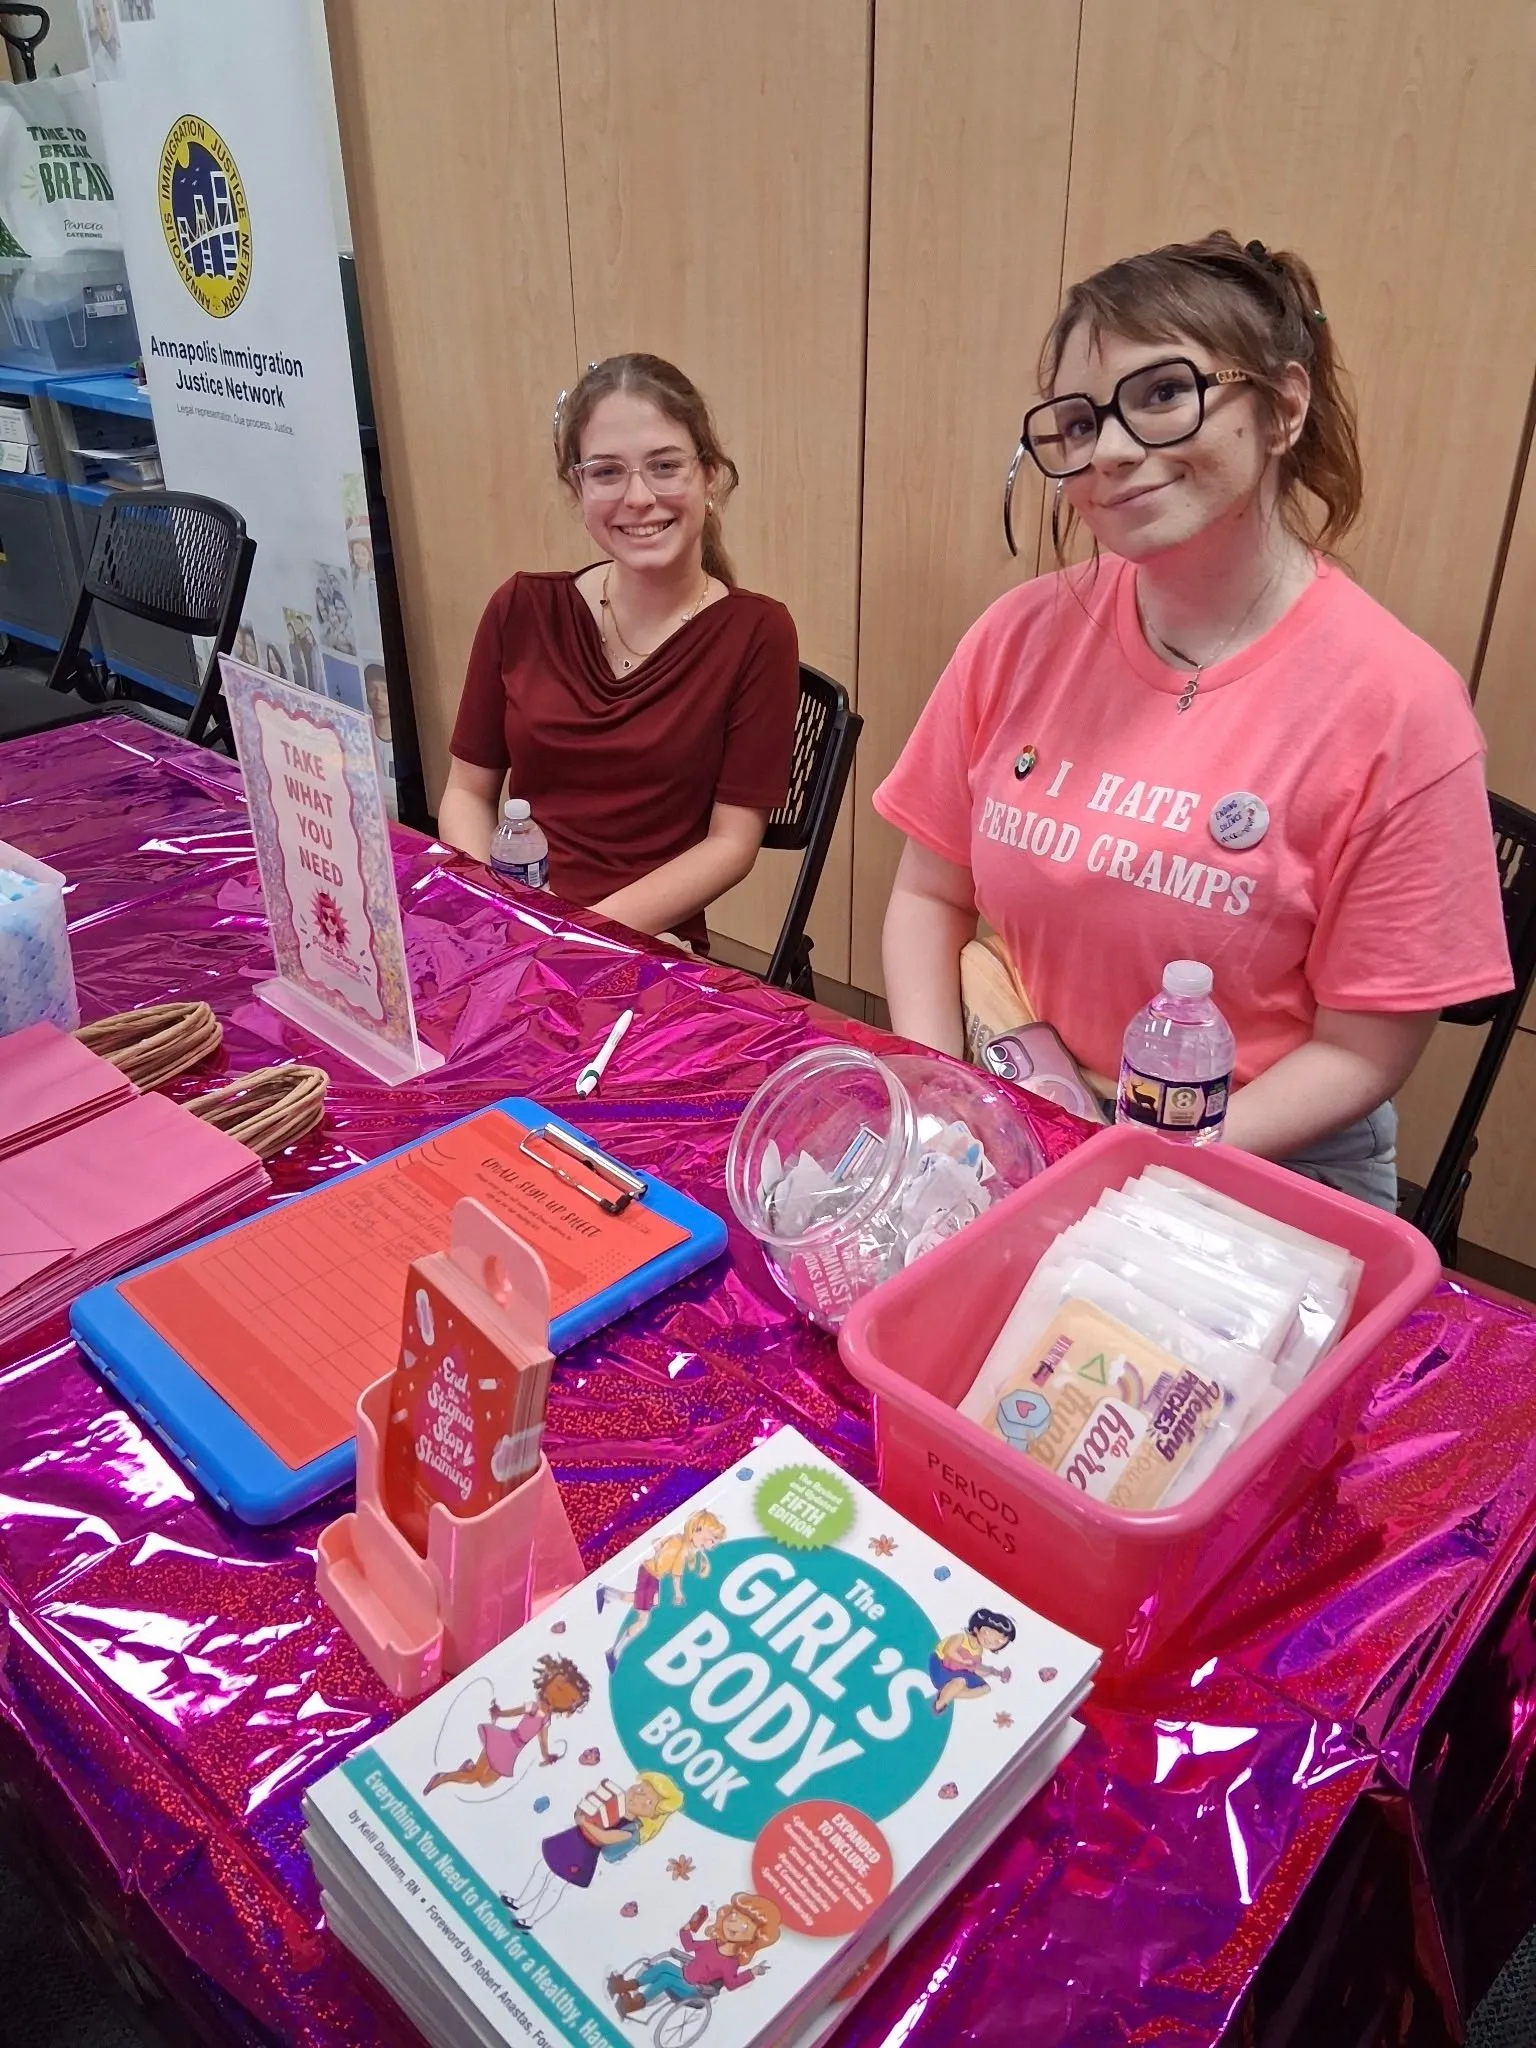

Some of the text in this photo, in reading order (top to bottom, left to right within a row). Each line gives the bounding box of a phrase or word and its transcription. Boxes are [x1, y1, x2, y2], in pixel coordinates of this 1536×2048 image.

[27, 126, 87, 142] TIME TO
[39, 144, 92, 159] BREAK
[39, 162, 114, 203] BREAD
[64, 219, 104, 231] Panera
[161, 120, 250, 314] IMMIGRATION JUSTICE NETWORK ANNAPOLIS
[151, 335, 304, 378] Annapolis Immigration
[176, 369, 286, 408] Justice Network
[177, 403, 194, 416] Legal
[234, 414, 246, 426] Due
[246, 417, 273, 431] process.
[280, 739, 326, 781] TAKE
[284, 774, 333, 818] WHAT
[1046, 760, 1201, 833] I HATE
[296, 813, 333, 850] YOU
[298, 845, 344, 887] NEED
[978, 797, 1258, 916] PERIOD CRAMPS
[813, 1281, 832, 1309] LIKE
[443, 1356, 469, 1393] End
[428, 1382, 474, 1432] Stigma
[433, 1415, 463, 1459] Stop
[1111, 1435, 1130, 1458] do
[415, 1434, 473, 1500] Shaming
[927, 1451, 1019, 1525] PERIOD
[767, 1503, 816, 1539] EDITION
[780, 1490, 827, 1526] FIFTH
[939, 1490, 1017, 1554] PACKS
[845, 1578, 885, 1621] The
[719, 1553, 938, 1741] GIRL'S
[644, 1610, 866, 1798] BODY
[638, 1706, 750, 1812] BOOK
[818, 1820, 834, 1837] TO
[831, 1812, 880, 1864] EXPANDED
[365, 1769, 421, 1840] Everything
[416, 1830, 439, 1860] You
[434, 1853, 470, 1892] Need
[462, 1886, 479, 1906] to
[473, 1898, 510, 1942] Know
[504, 1935, 528, 1961] for
[521, 1958, 536, 1973] a
[530, 1965, 582, 2029] Healthy,
[348, 1809, 361, 1824] by
[357, 1821, 380, 1845] Kelli
[374, 1840, 406, 1883] Dunham,
[404, 1879, 422, 1896] RN
[426, 1905, 466, 1950] Foreword
[461, 1946, 475, 1963] by
[471, 1959, 505, 1995] Robert
[496, 1987, 533, 2035] Anastas,
